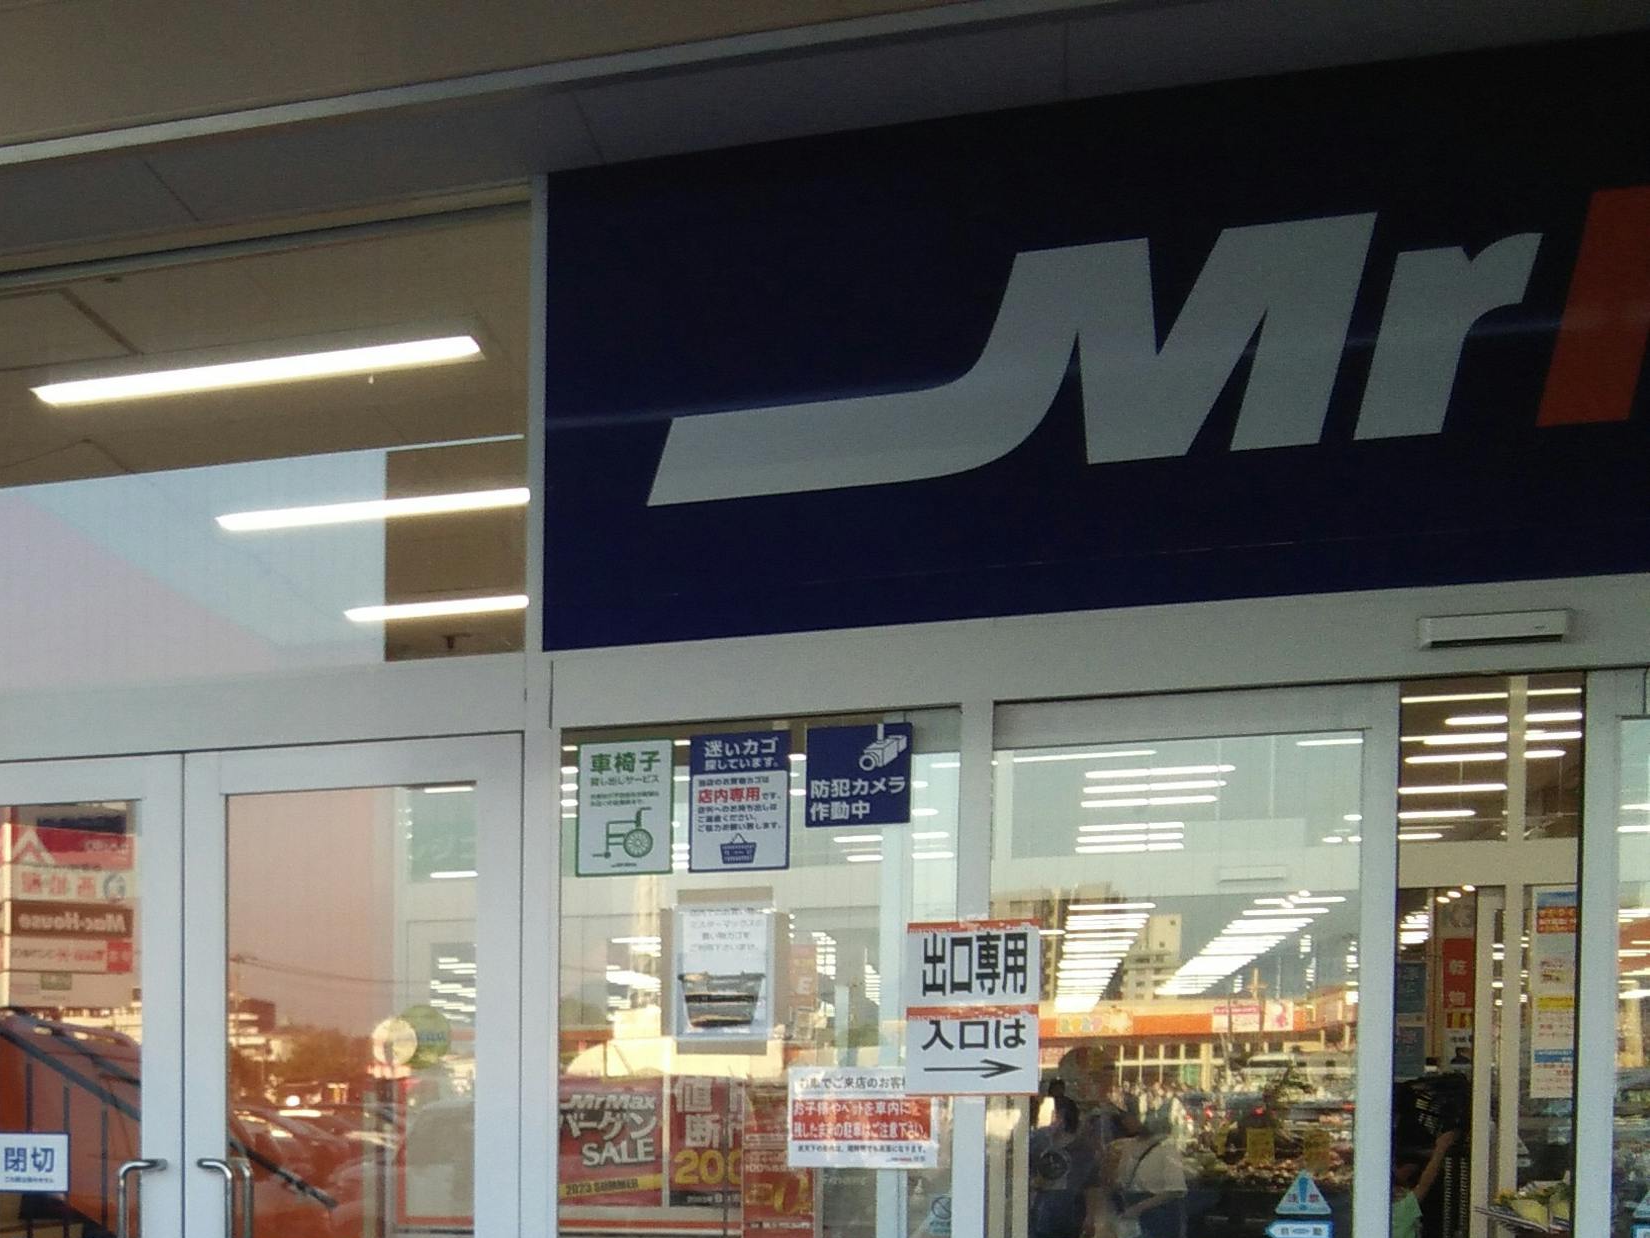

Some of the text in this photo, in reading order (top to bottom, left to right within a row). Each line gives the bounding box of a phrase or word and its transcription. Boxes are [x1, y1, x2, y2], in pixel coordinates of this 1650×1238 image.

[647, 187, 1650, 507] Mr
[704, 736, 780, 758] 迷いカゴ
[590, 750, 661, 774] 車椅子
[810, 776, 906, 799] 防犯カメラ
[810, 800, 871, 821] 作動中
[921, 931, 1029, 997] 出口専用
[921, 1018, 1027, 1051] 入口は
[559, 1094, 656, 1110] MrMax
[558, 1110, 657, 1141] バーゲン
[3, 1146, 56, 1174] 閉切
[582, 1138, 656, 1167] SALE
[594, 1178, 639, 1193] SUMMER
